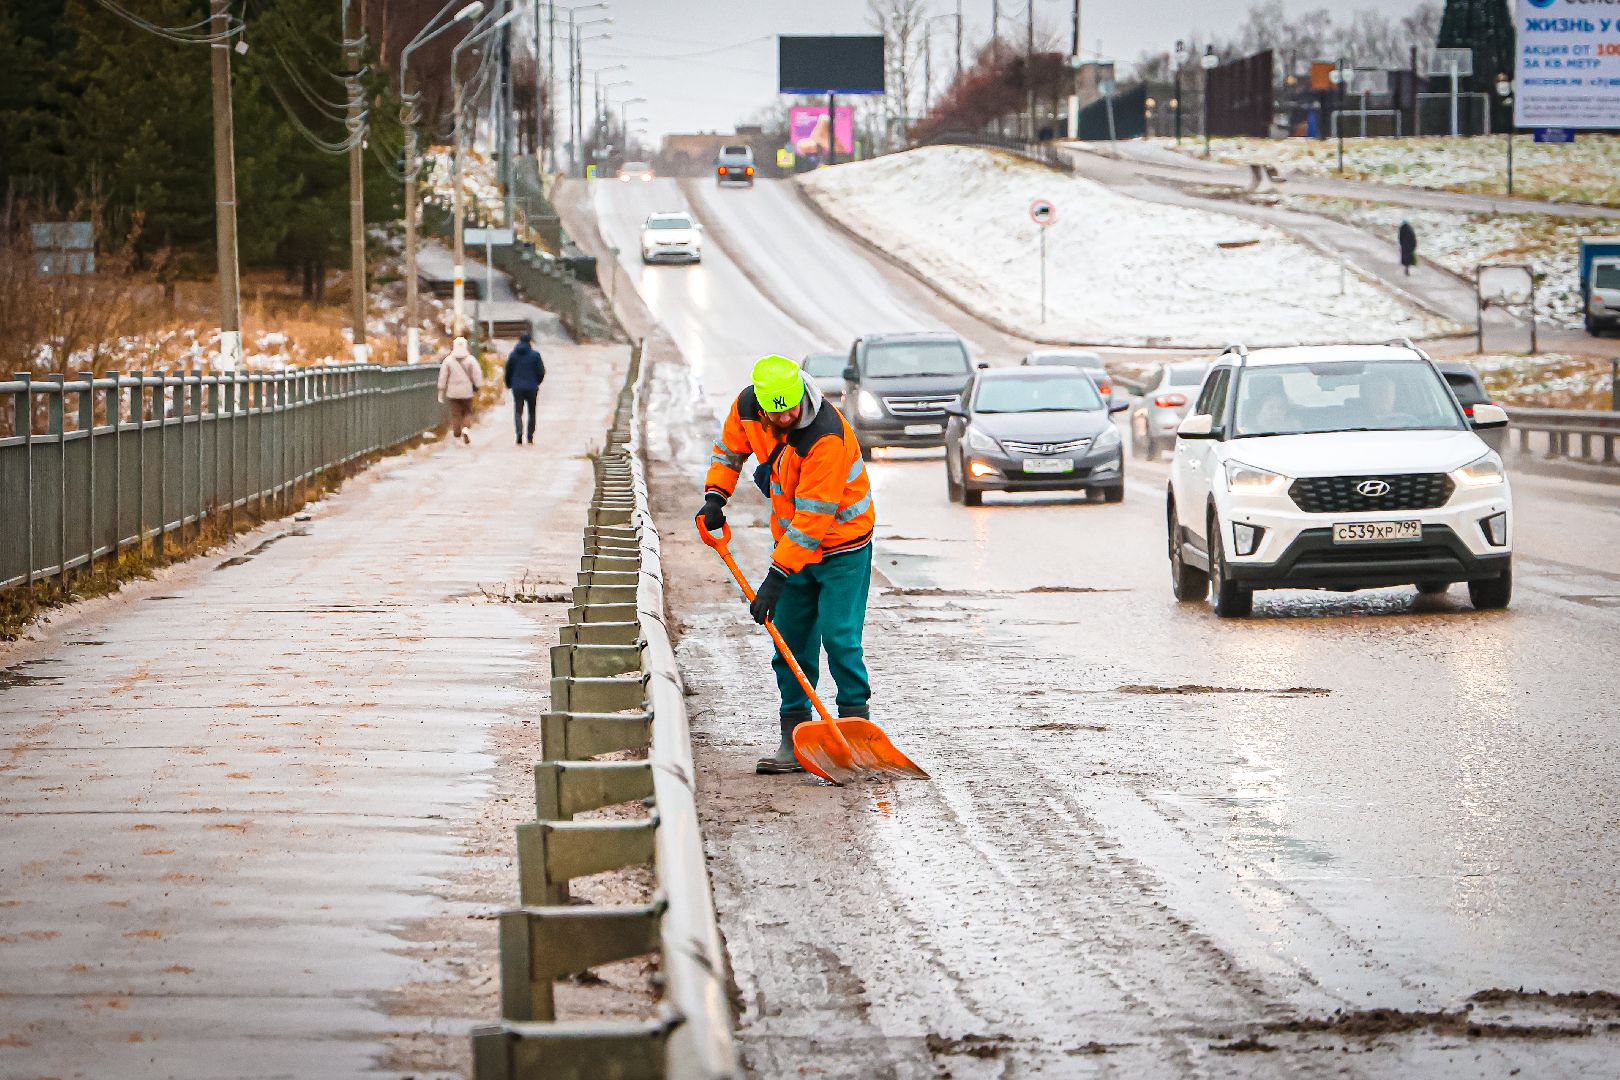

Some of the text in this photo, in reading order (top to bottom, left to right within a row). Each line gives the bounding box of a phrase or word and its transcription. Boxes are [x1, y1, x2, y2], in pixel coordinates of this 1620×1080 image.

[1525, 18, 1595, 32] ЖИЗНЬ
[1600, 18, 1611, 32] У
[1524, 45, 1568, 55] АКЦИЯ
[1573, 45, 1591, 55] ОТ
[1524, 58, 1539, 68] ЗА
[1566, 59, 1601, 68] МЕТР
[773, 396, 787, 410] NY
